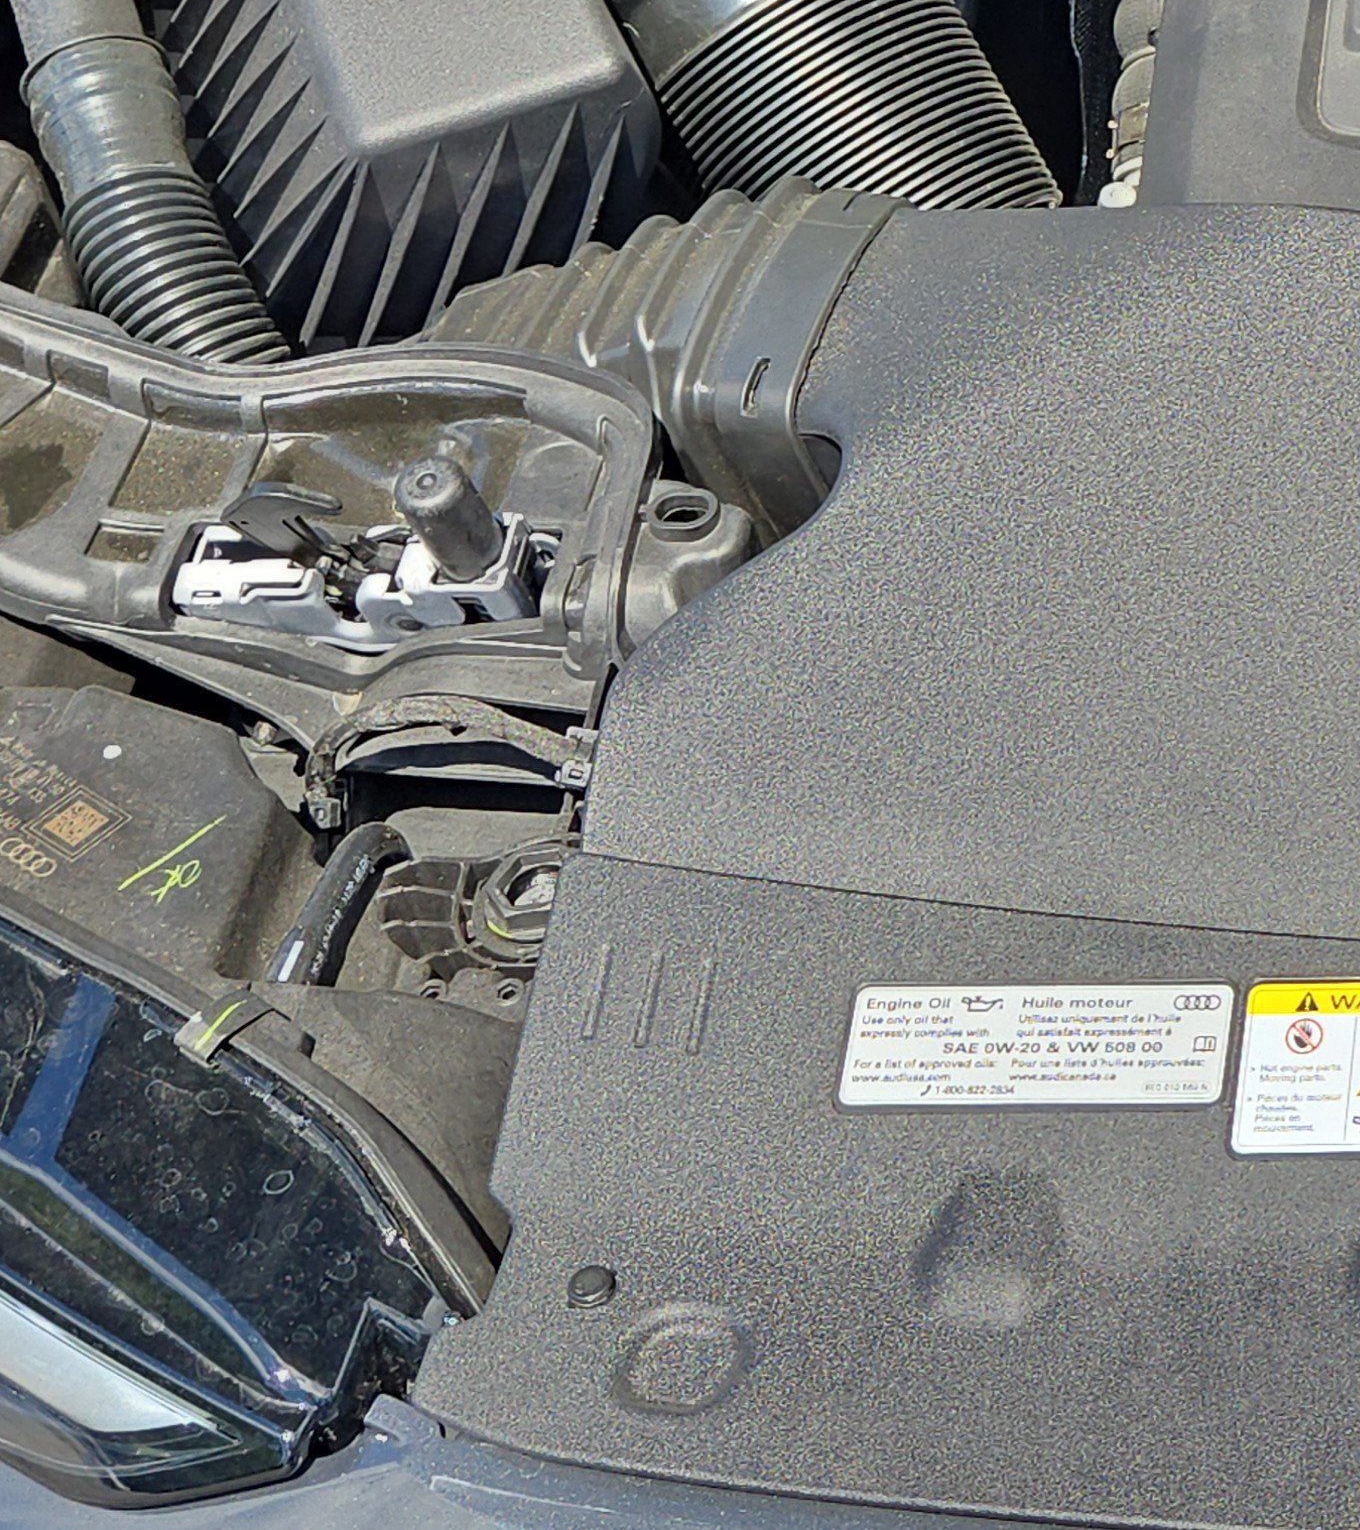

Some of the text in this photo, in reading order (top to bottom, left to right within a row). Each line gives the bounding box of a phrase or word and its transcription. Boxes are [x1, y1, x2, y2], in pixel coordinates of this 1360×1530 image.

[867, 997, 951, 1011] Engine Oil
[1022, 997, 1133, 1009] Huile moteur
[862, 1015, 954, 1026] Use only oil that
[1019, 1014, 1058, 1024] Utilisez
[1061, 1014, 1128, 1026] uniquement
[1131, 1015, 1144, 1024] de
[860, 1027, 990, 1039] expressly complies with
[1017, 1027, 1035, 1037] qui
[1038, 1027, 1081, 1037] satisfait
[943, 1042, 1163, 1054] SAE 0W-20 & VW 508 00
[853, 1059, 873, 1069] For
[875, 1060, 882, 1069] a
[885, 1059, 901, 1068] list
[904, 1059, 917, 1068] of
[919, 1059, 971, 1070] approved
[1011, 1058, 1036, 1068] Pour
[1040, 1059, 1060, 1068] une
[1064, 1058, 1087, 1068] liste
[852, 1073, 951, 1083] www.audiusa.com
